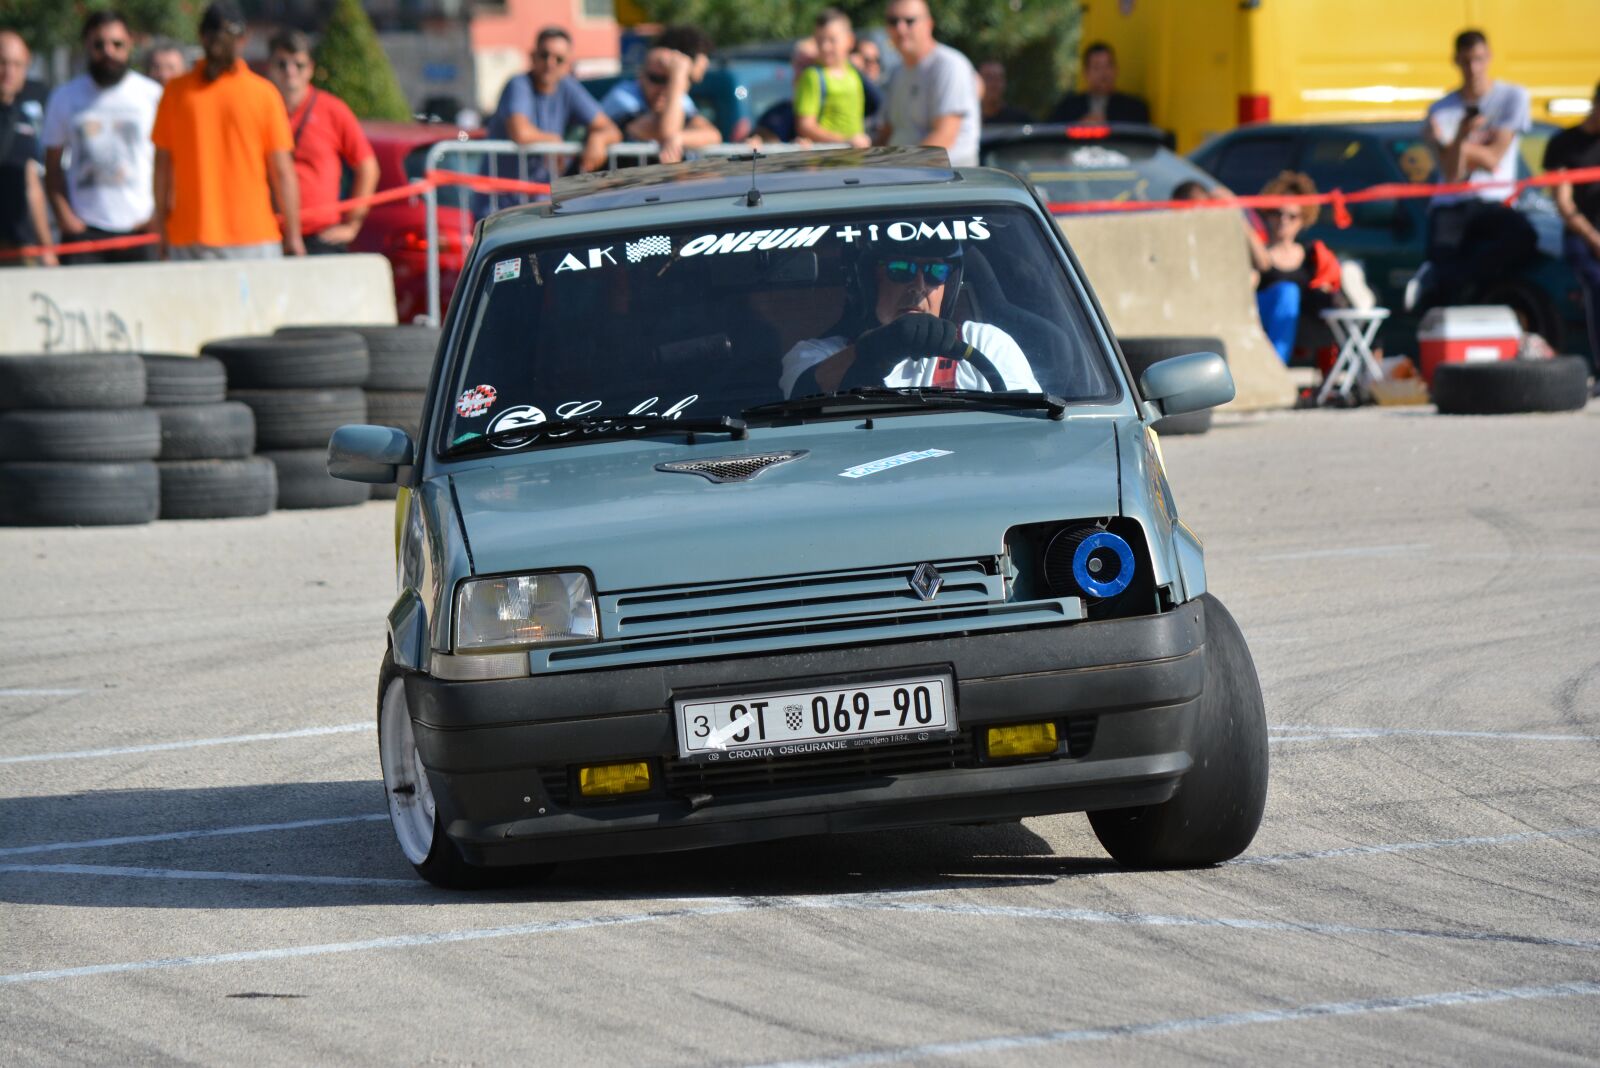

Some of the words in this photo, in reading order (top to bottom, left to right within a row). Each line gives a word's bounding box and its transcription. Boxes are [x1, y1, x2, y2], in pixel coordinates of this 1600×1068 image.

[554, 246, 617, 274] AK
[679, 225, 831, 257] ONEUM
[886, 216, 991, 241] OMIŠ
[693, 715, 710, 737] 3
[811, 685, 933, 735] 069-90
[728, 747, 774, 759] CROATIA
[779, 740, 848, 754] OSIGURANJE
